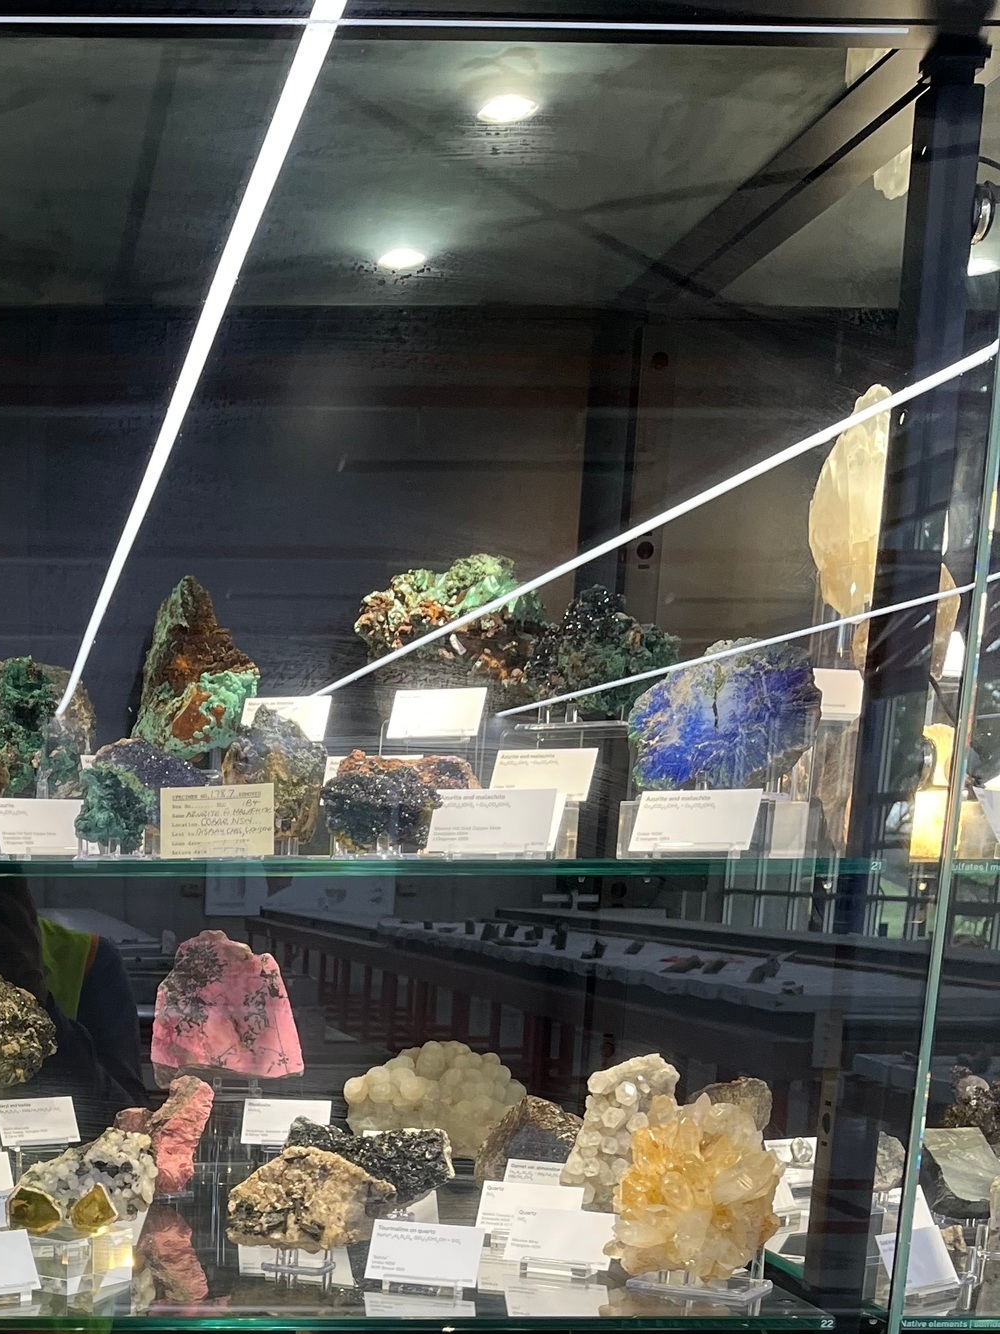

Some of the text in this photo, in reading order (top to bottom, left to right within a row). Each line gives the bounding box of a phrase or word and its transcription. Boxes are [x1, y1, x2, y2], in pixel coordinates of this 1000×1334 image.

[870, 861, 882, 871] 21
[378, 1225, 409, 1233] Tourmaline
[820, 1319, 834, 1328] 22
[901, 1319, 968, 1328] Native elements
